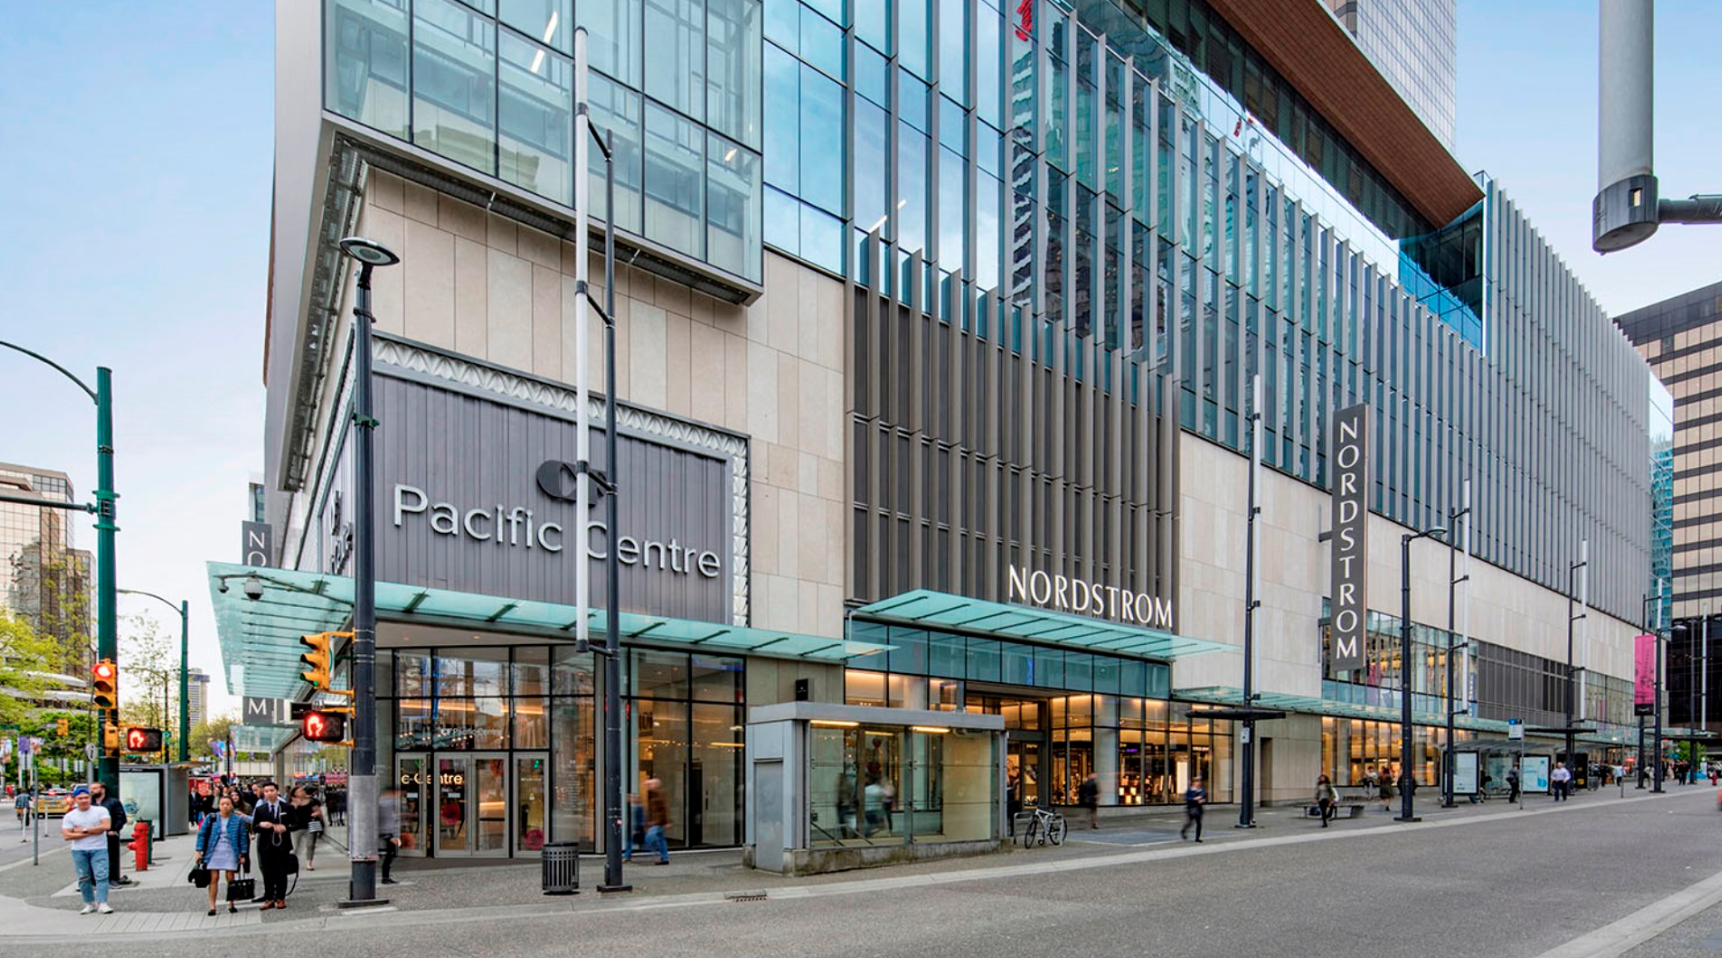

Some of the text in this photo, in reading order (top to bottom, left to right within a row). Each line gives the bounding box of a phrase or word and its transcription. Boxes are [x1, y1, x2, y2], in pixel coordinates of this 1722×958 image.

[394, 484, 563, 552] Pacific
[586, 521, 721, 578] Centre
[1335, 416, 1360, 660] NORDSTROM
[1009, 564, 1173, 628] NORDSTROM
